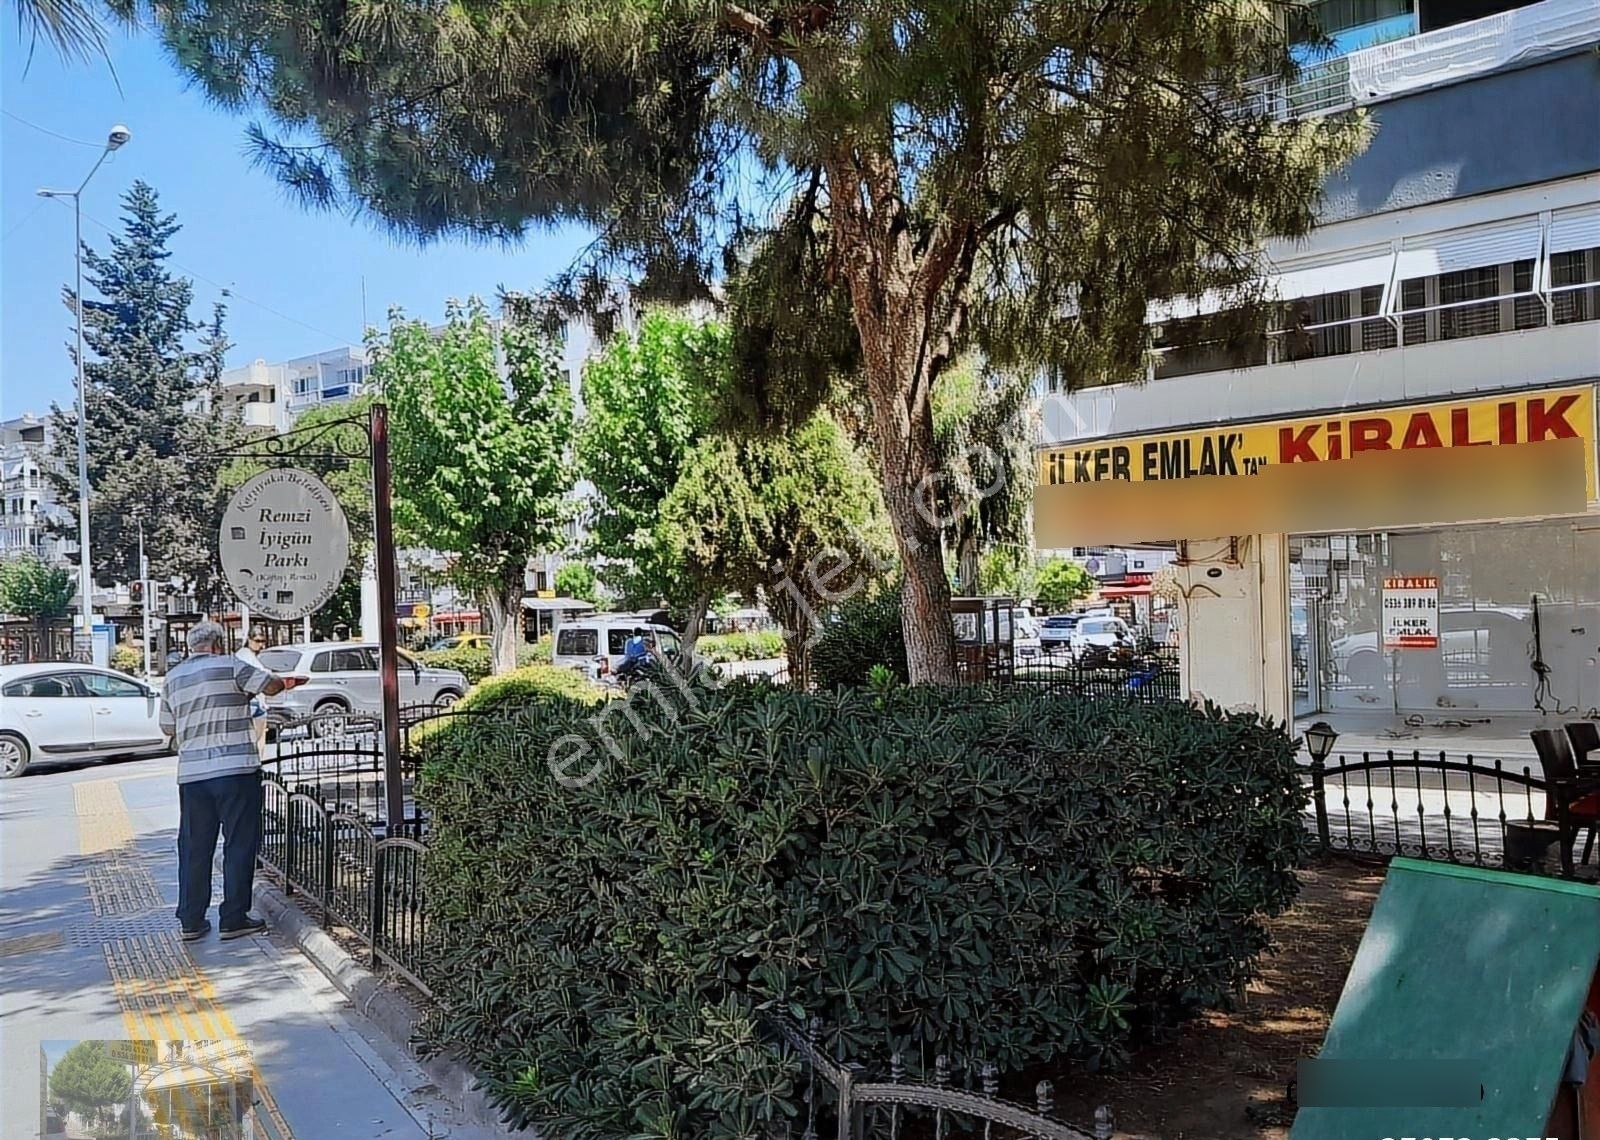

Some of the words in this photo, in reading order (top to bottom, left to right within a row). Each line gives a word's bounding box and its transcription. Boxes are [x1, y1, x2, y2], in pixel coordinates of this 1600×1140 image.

[259, 508, 311, 523] Remzi
[259, 528, 312, 550] İyigün
[264, 553, 308, 567] Parkı
